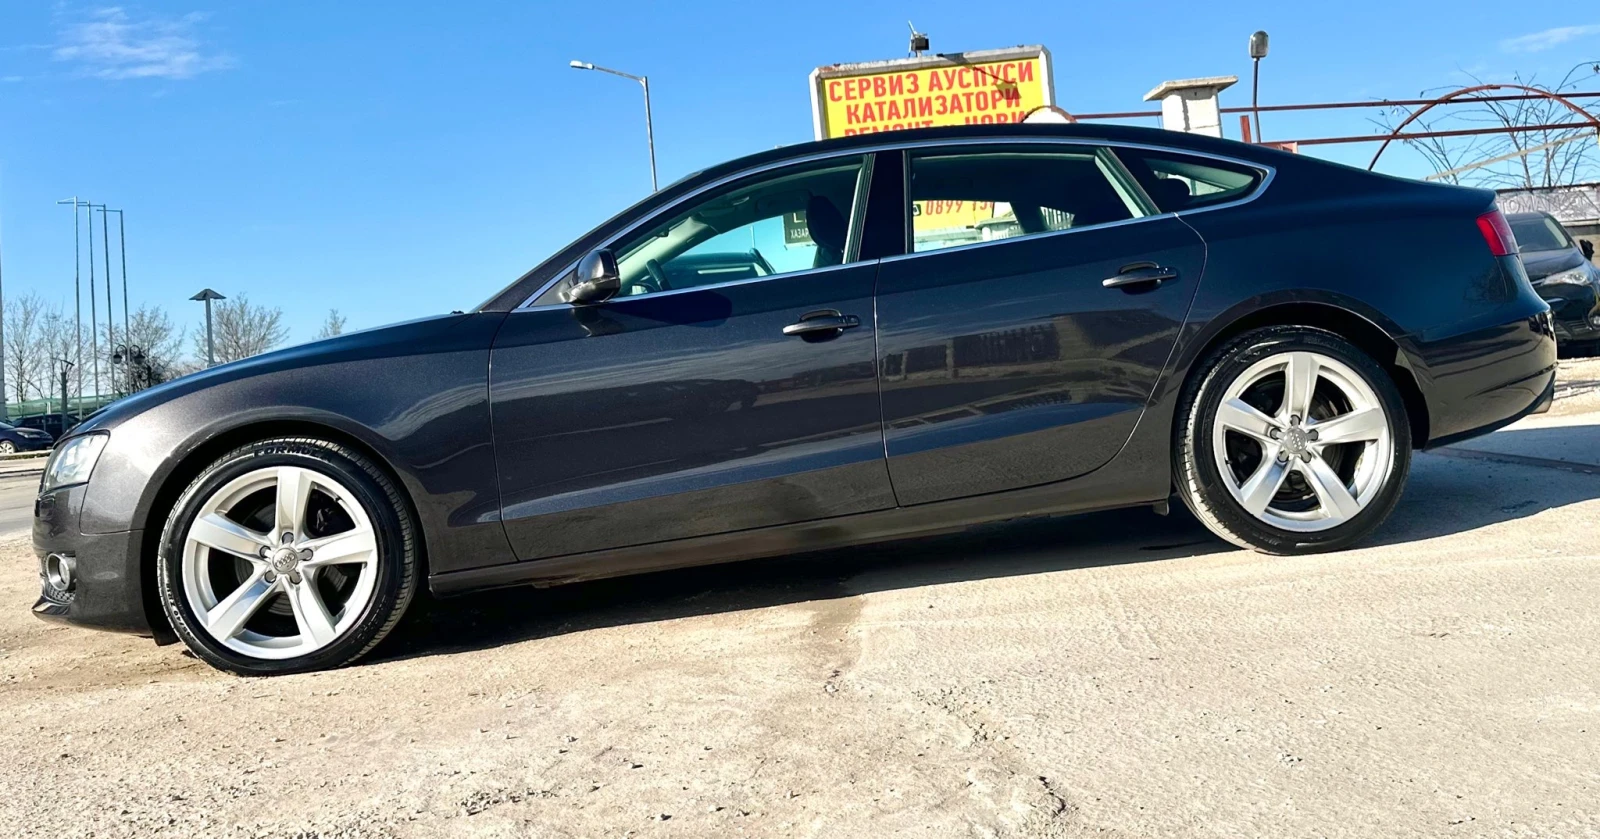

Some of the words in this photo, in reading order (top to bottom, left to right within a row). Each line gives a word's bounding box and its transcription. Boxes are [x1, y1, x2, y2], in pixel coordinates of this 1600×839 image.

[829, 73, 919, 102] СЕРВИЗ
[928, 61, 1033, 91] АУСПУСИ
[846, 88, 1020, 125] КАТАЛИЗАТОРИ
[926, 200, 963, 215] 0899
